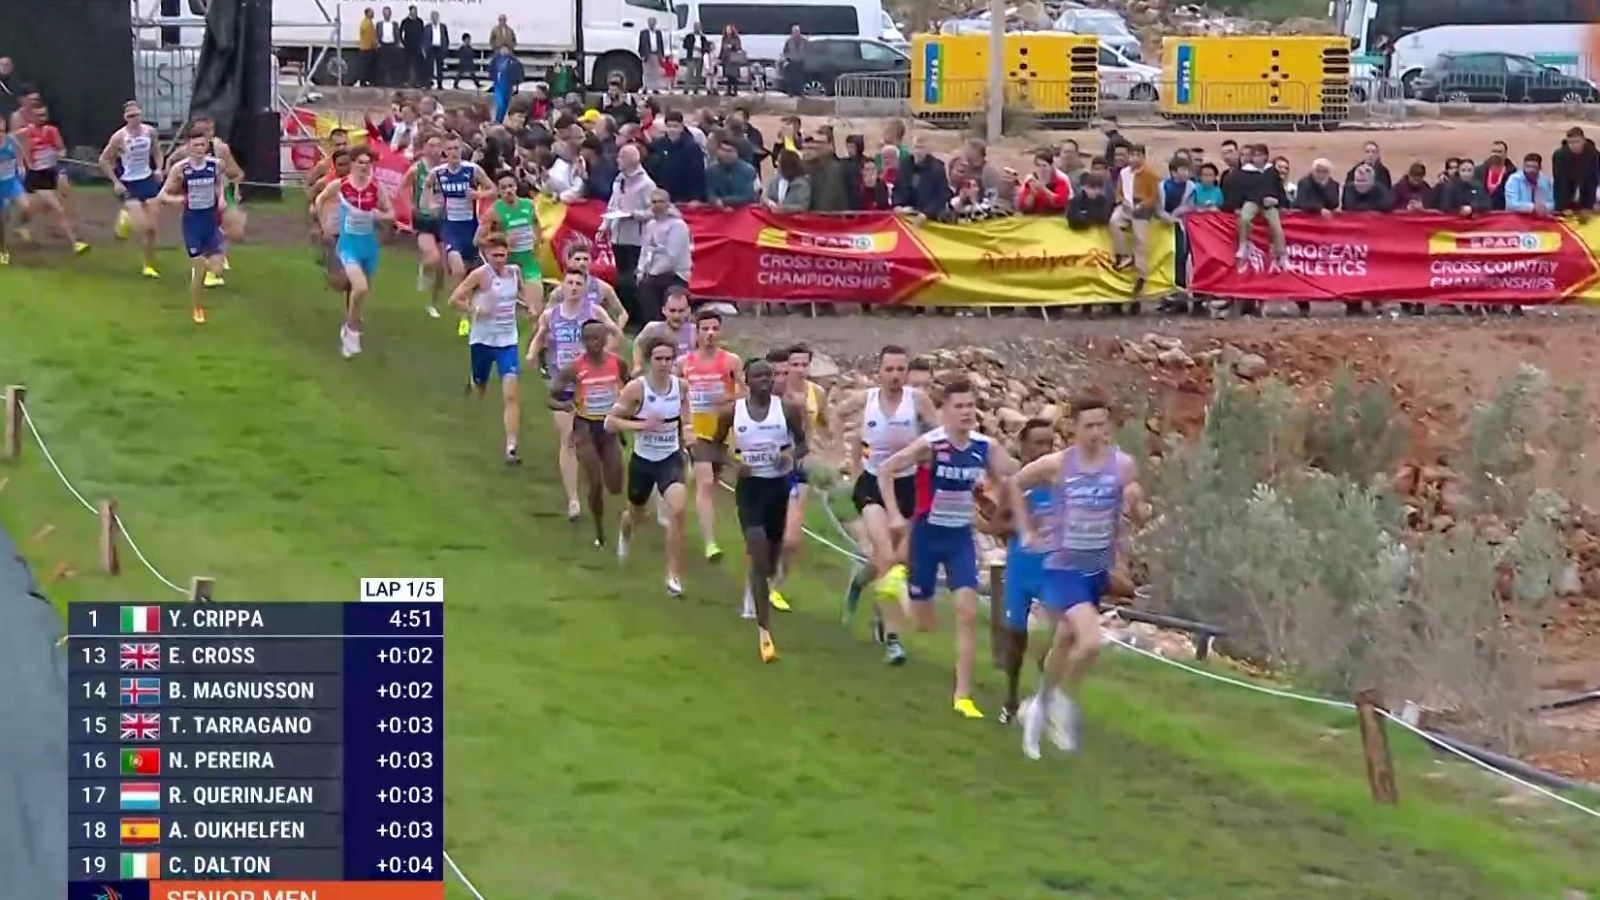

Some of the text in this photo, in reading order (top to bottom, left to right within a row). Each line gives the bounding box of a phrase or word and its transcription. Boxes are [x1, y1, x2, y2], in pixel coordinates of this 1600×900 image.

[759, 252, 892, 274] CROSS COUNTRY
[1429, 258, 1559, 275] CROSS COUNTRY
[757, 269, 894, 289] CHAMPIONSHIPS
